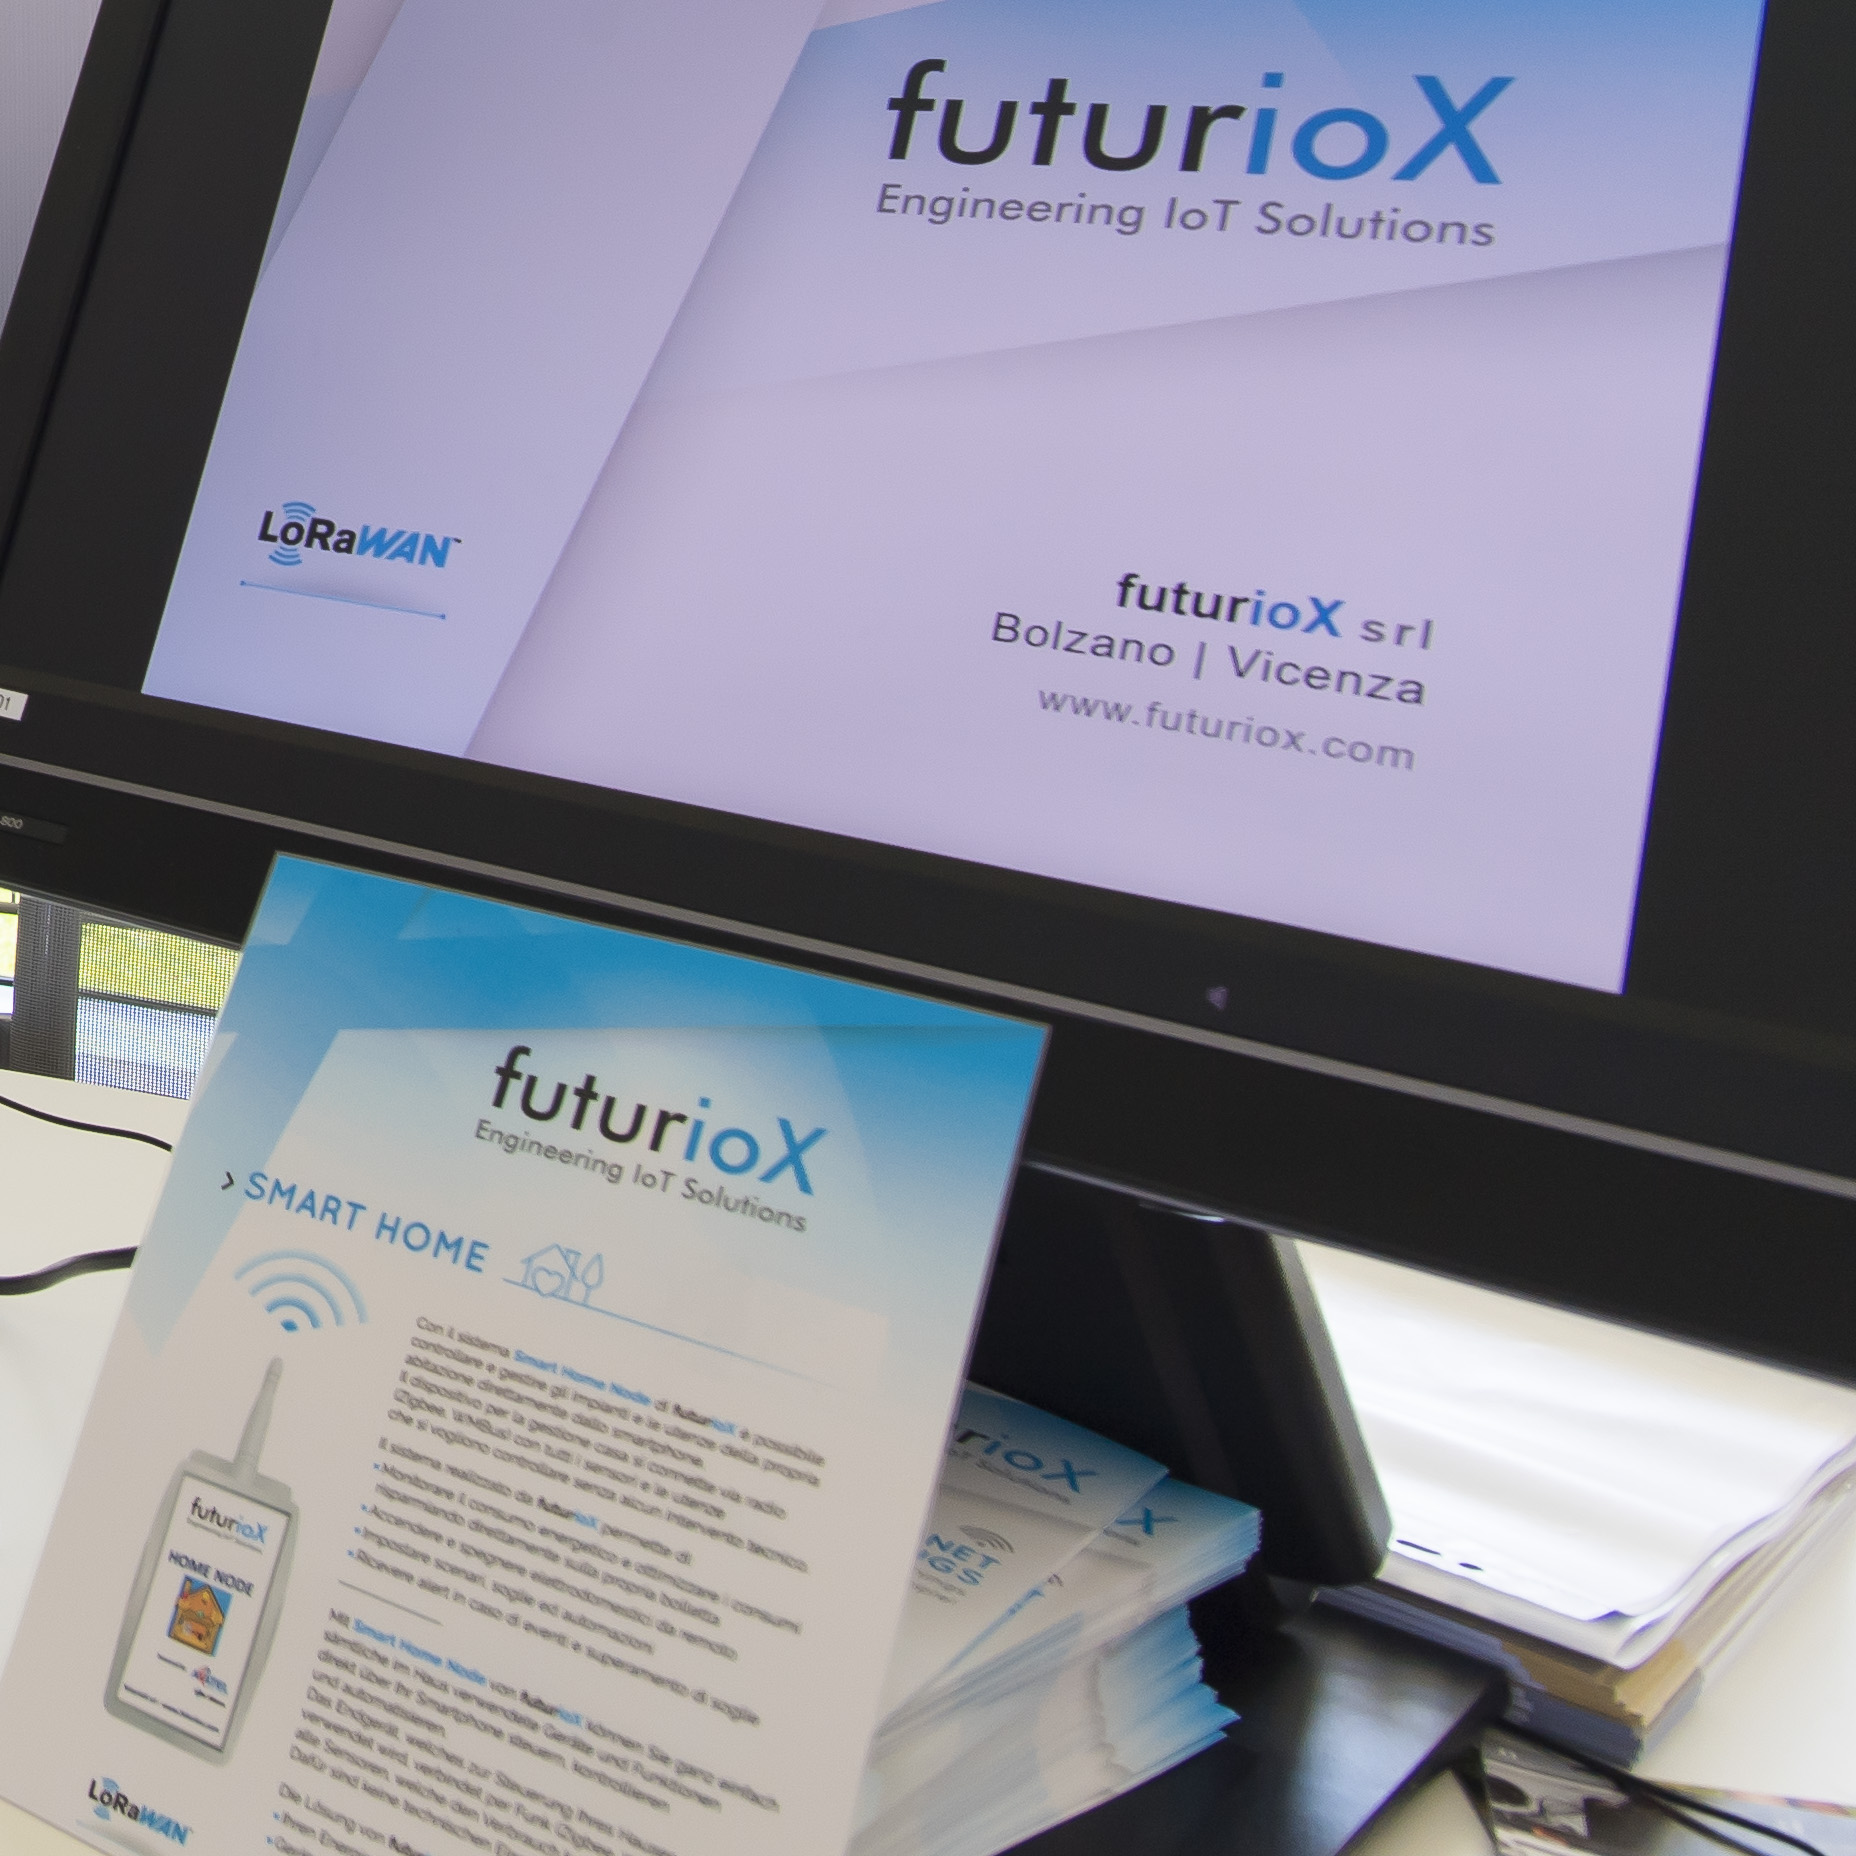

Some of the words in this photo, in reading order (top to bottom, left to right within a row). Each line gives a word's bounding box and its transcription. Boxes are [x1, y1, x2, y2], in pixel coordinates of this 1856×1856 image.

[887, 58, 1516, 186] futurioX
[876, 182, 1147, 236] Engineering
[1163, 197, 1242, 233] IoT
[1255, 199, 1497, 248] Solutions
[1116, 572, 1346, 638] futurioX
[1359, 619, 1436, 651] srl
[991, 611, 1176, 668] Bolzano
[1227, 644, 1427, 705] Vicenza
[1037, 689, 1416, 771] www.futuriox.com
[489, 1044, 829, 1196] futurioX
[474, 1118, 625, 1185] Engineering
[631, 1162, 677, 1195] IoT
[679, 1176, 808, 1234] Solutions
[244, 1171, 368, 1232] SMART
[375, 1211, 489, 1274] HOME
[190, 1495, 270, 1545] futurioX
[168, 1548, 211, 1580] HOME
[214, 1568, 255, 1598] NODE
